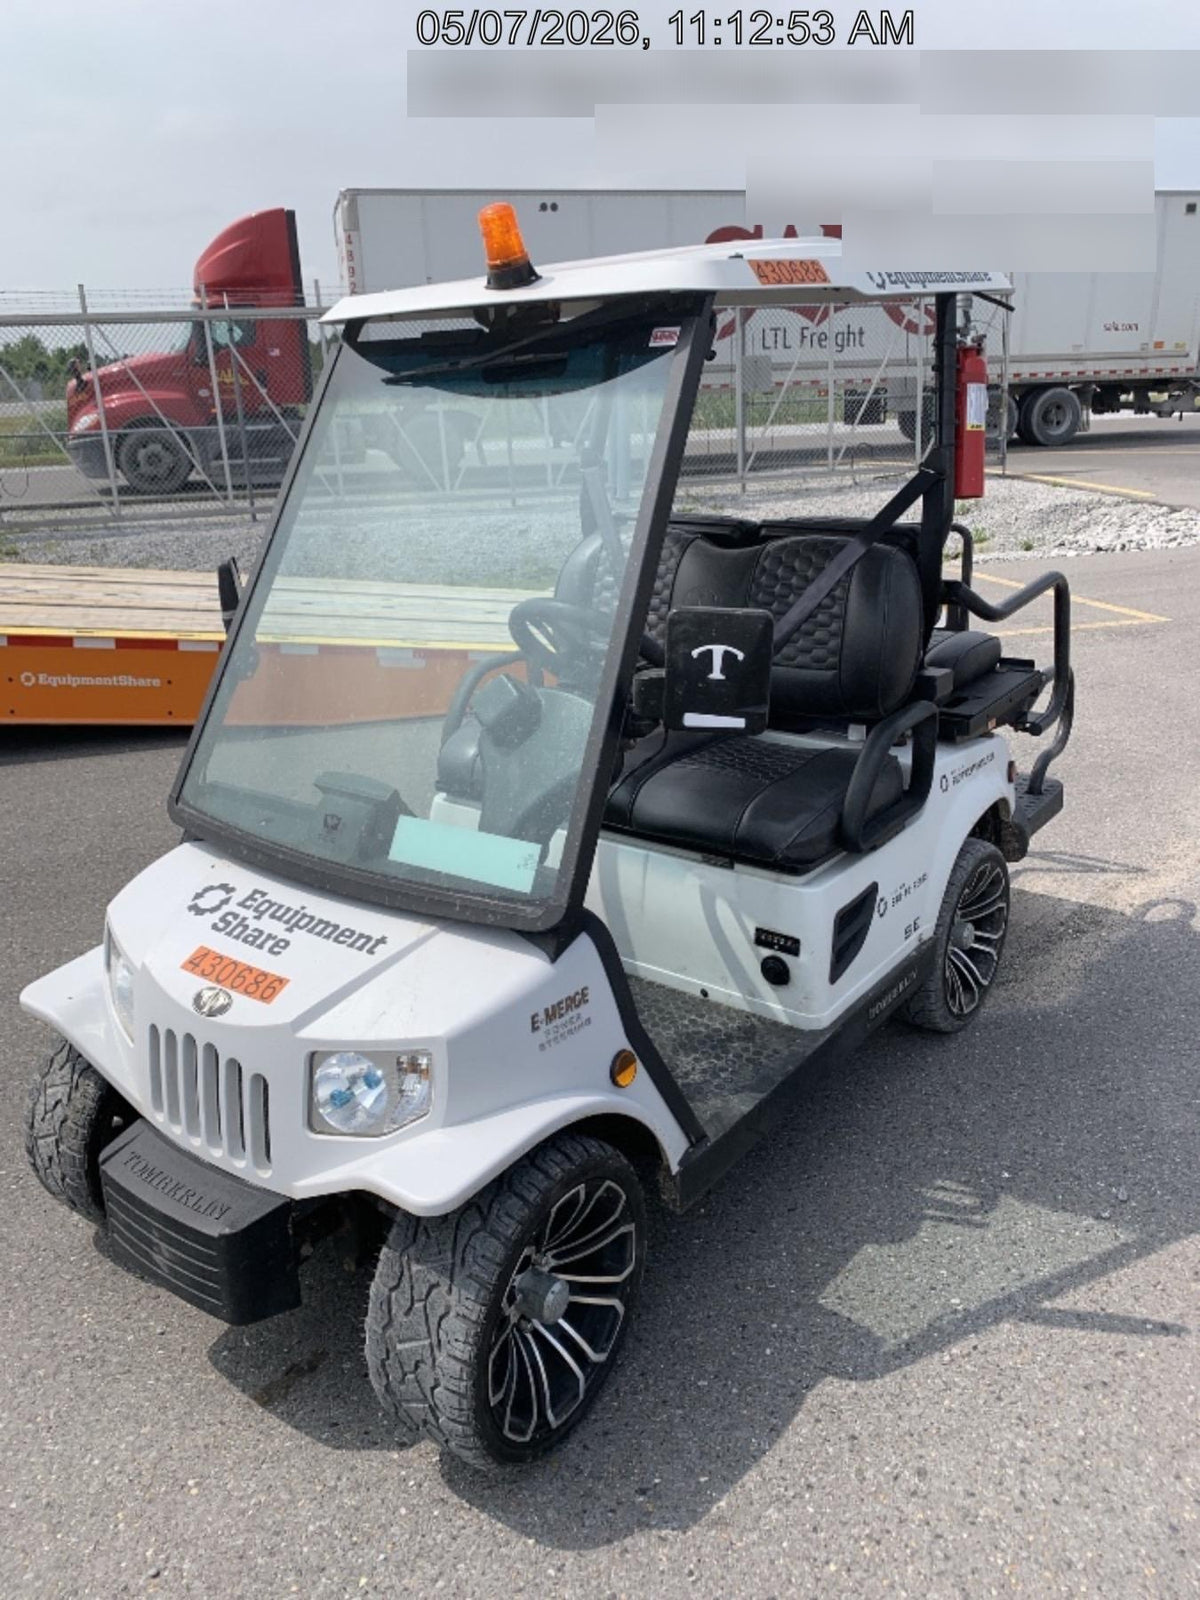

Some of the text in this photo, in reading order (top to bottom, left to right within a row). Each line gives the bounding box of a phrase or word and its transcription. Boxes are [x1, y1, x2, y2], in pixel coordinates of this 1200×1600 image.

[756, 260, 829, 283] 430686
[762, 323, 865, 353] LTL Freght
[38, 673, 161, 687] EquipmentShare
[691, 644, 745, 680] T
[212, 911, 290, 956] Share
[237, 888, 388, 955] Equipment
[187, 947, 285, 1001] 430686
